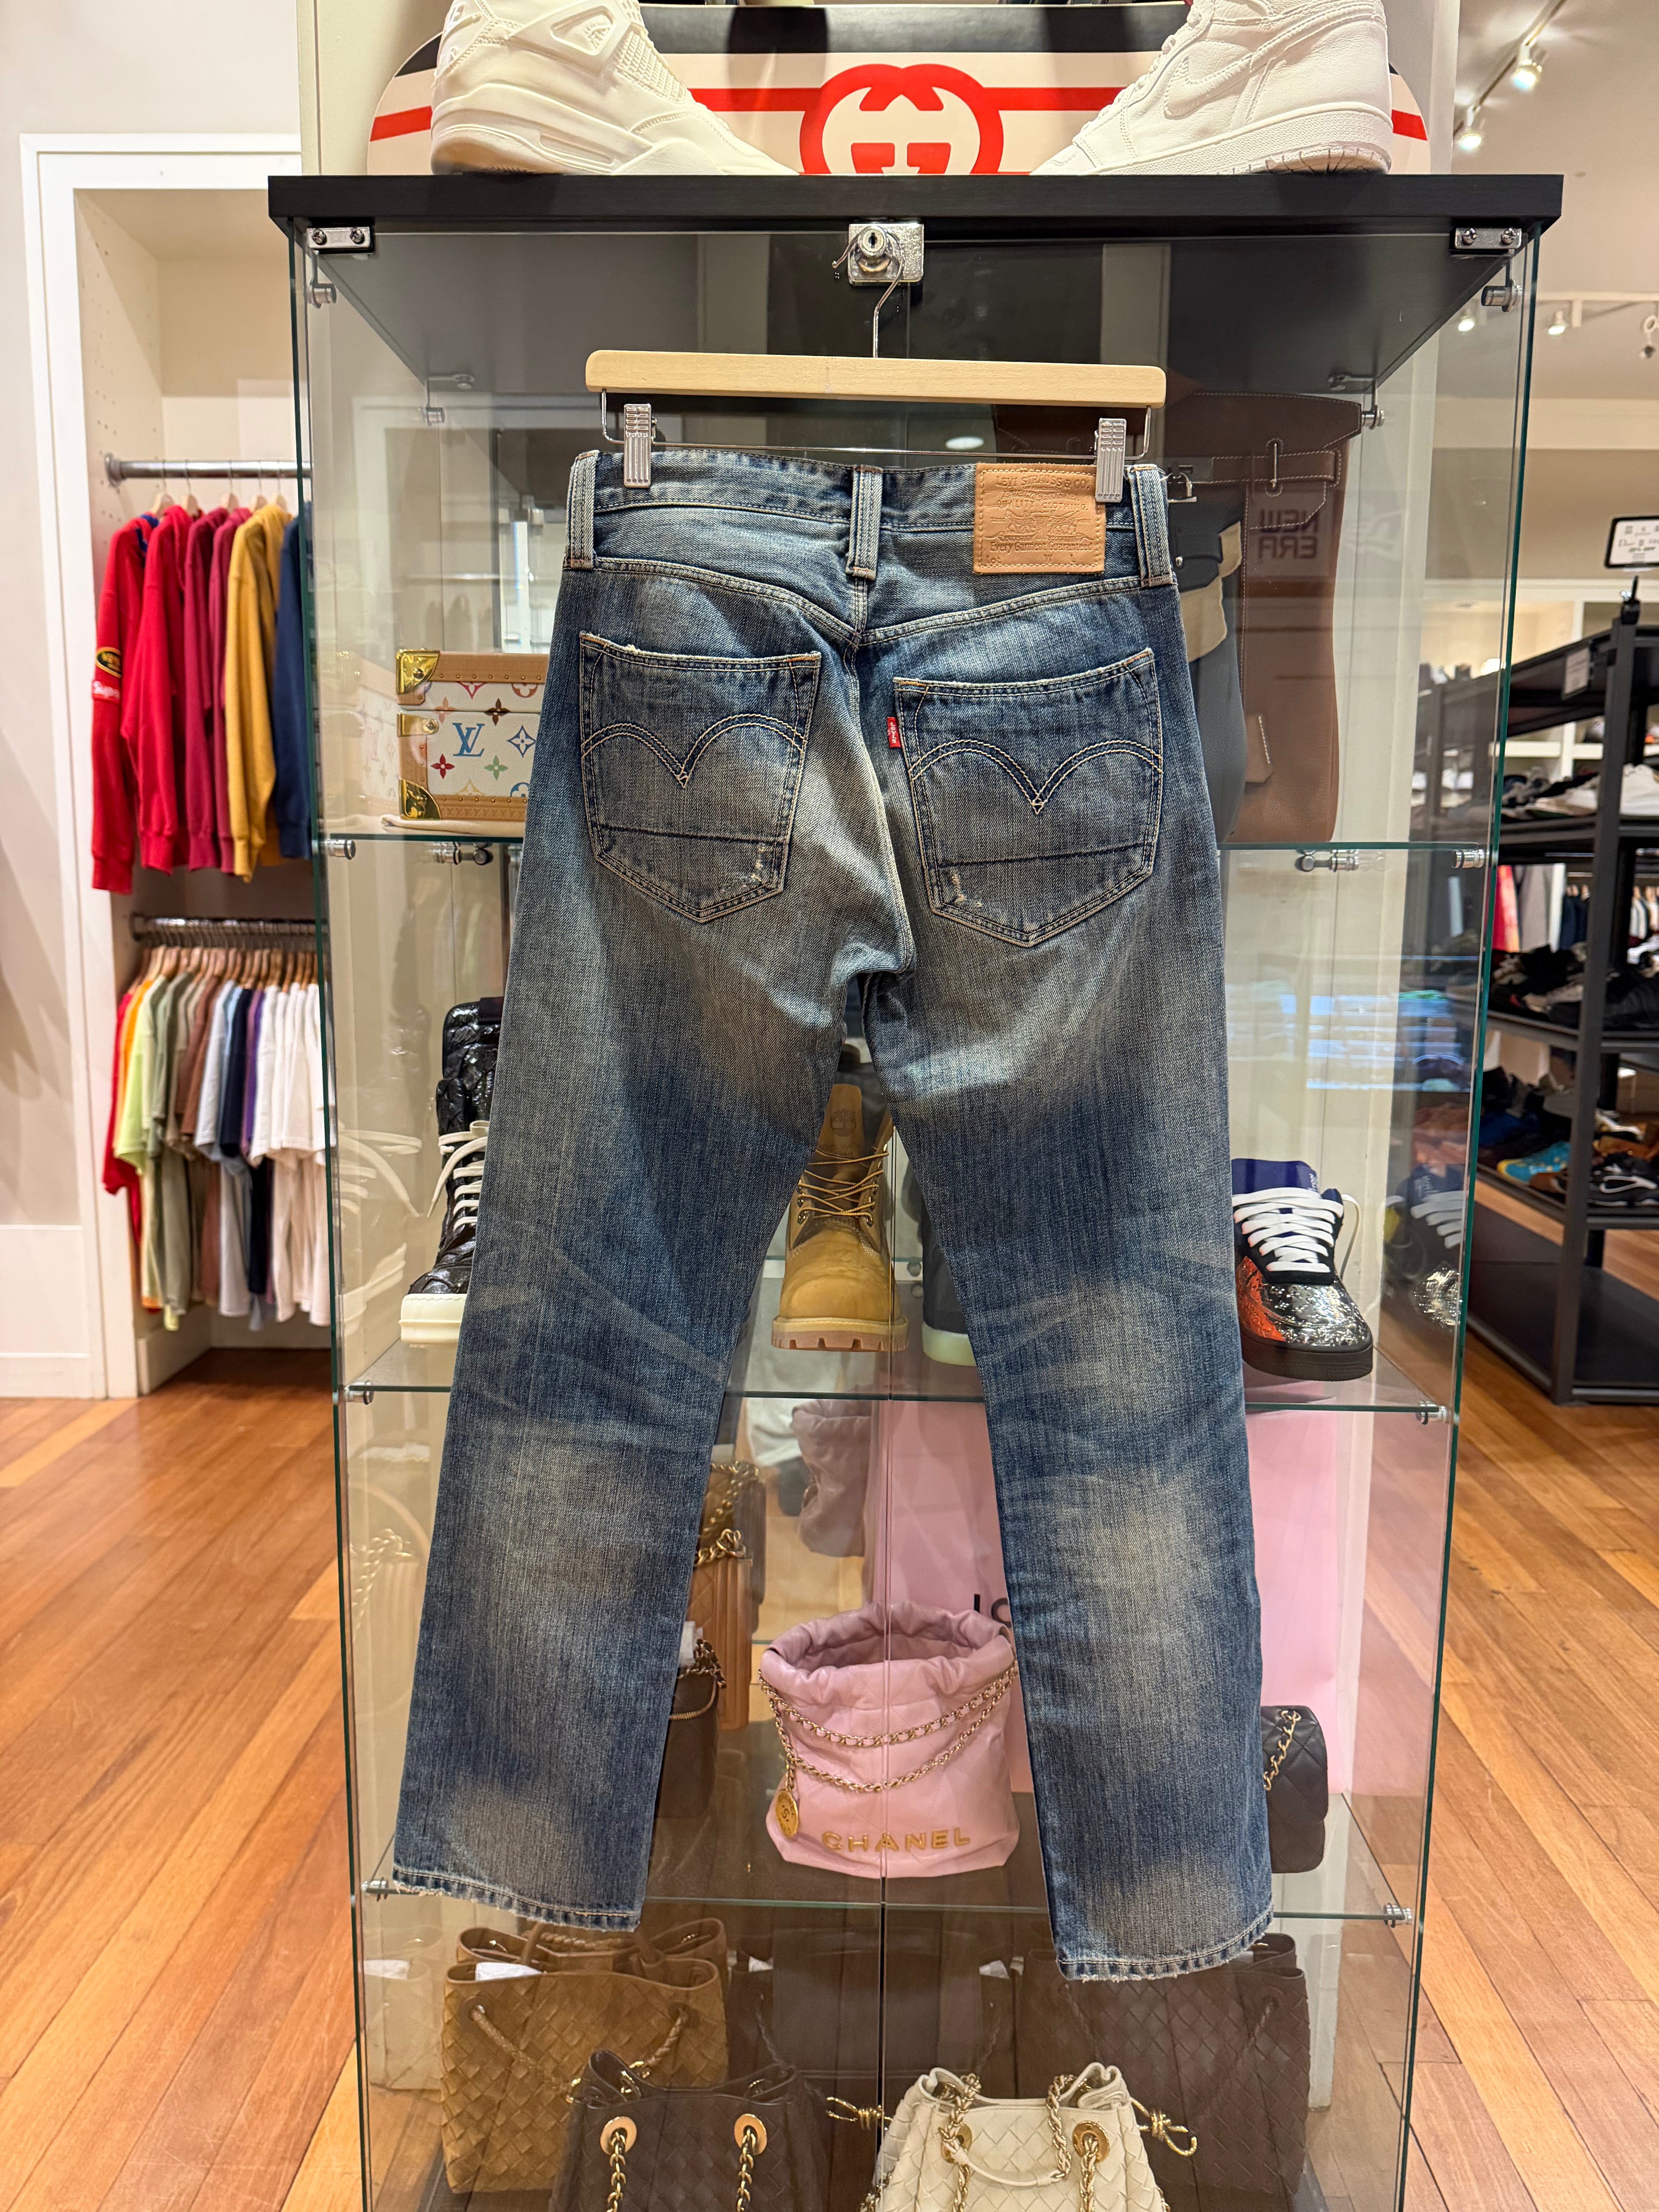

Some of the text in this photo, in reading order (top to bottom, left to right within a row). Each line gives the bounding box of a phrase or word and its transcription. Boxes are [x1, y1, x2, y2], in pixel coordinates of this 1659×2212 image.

[995, 475, 1017, 488] LEVI
[1021, 474, 1063, 488] STRAUSS
[1063, 479, 1072, 489] &
[1073, 478, 1090, 490] CO.
[997, 500, 1035, 510] QUALITY
[990, 541, 1094, 555] Every Garment Guaranteed
[822, 1827, 971, 1853] CHANEL
